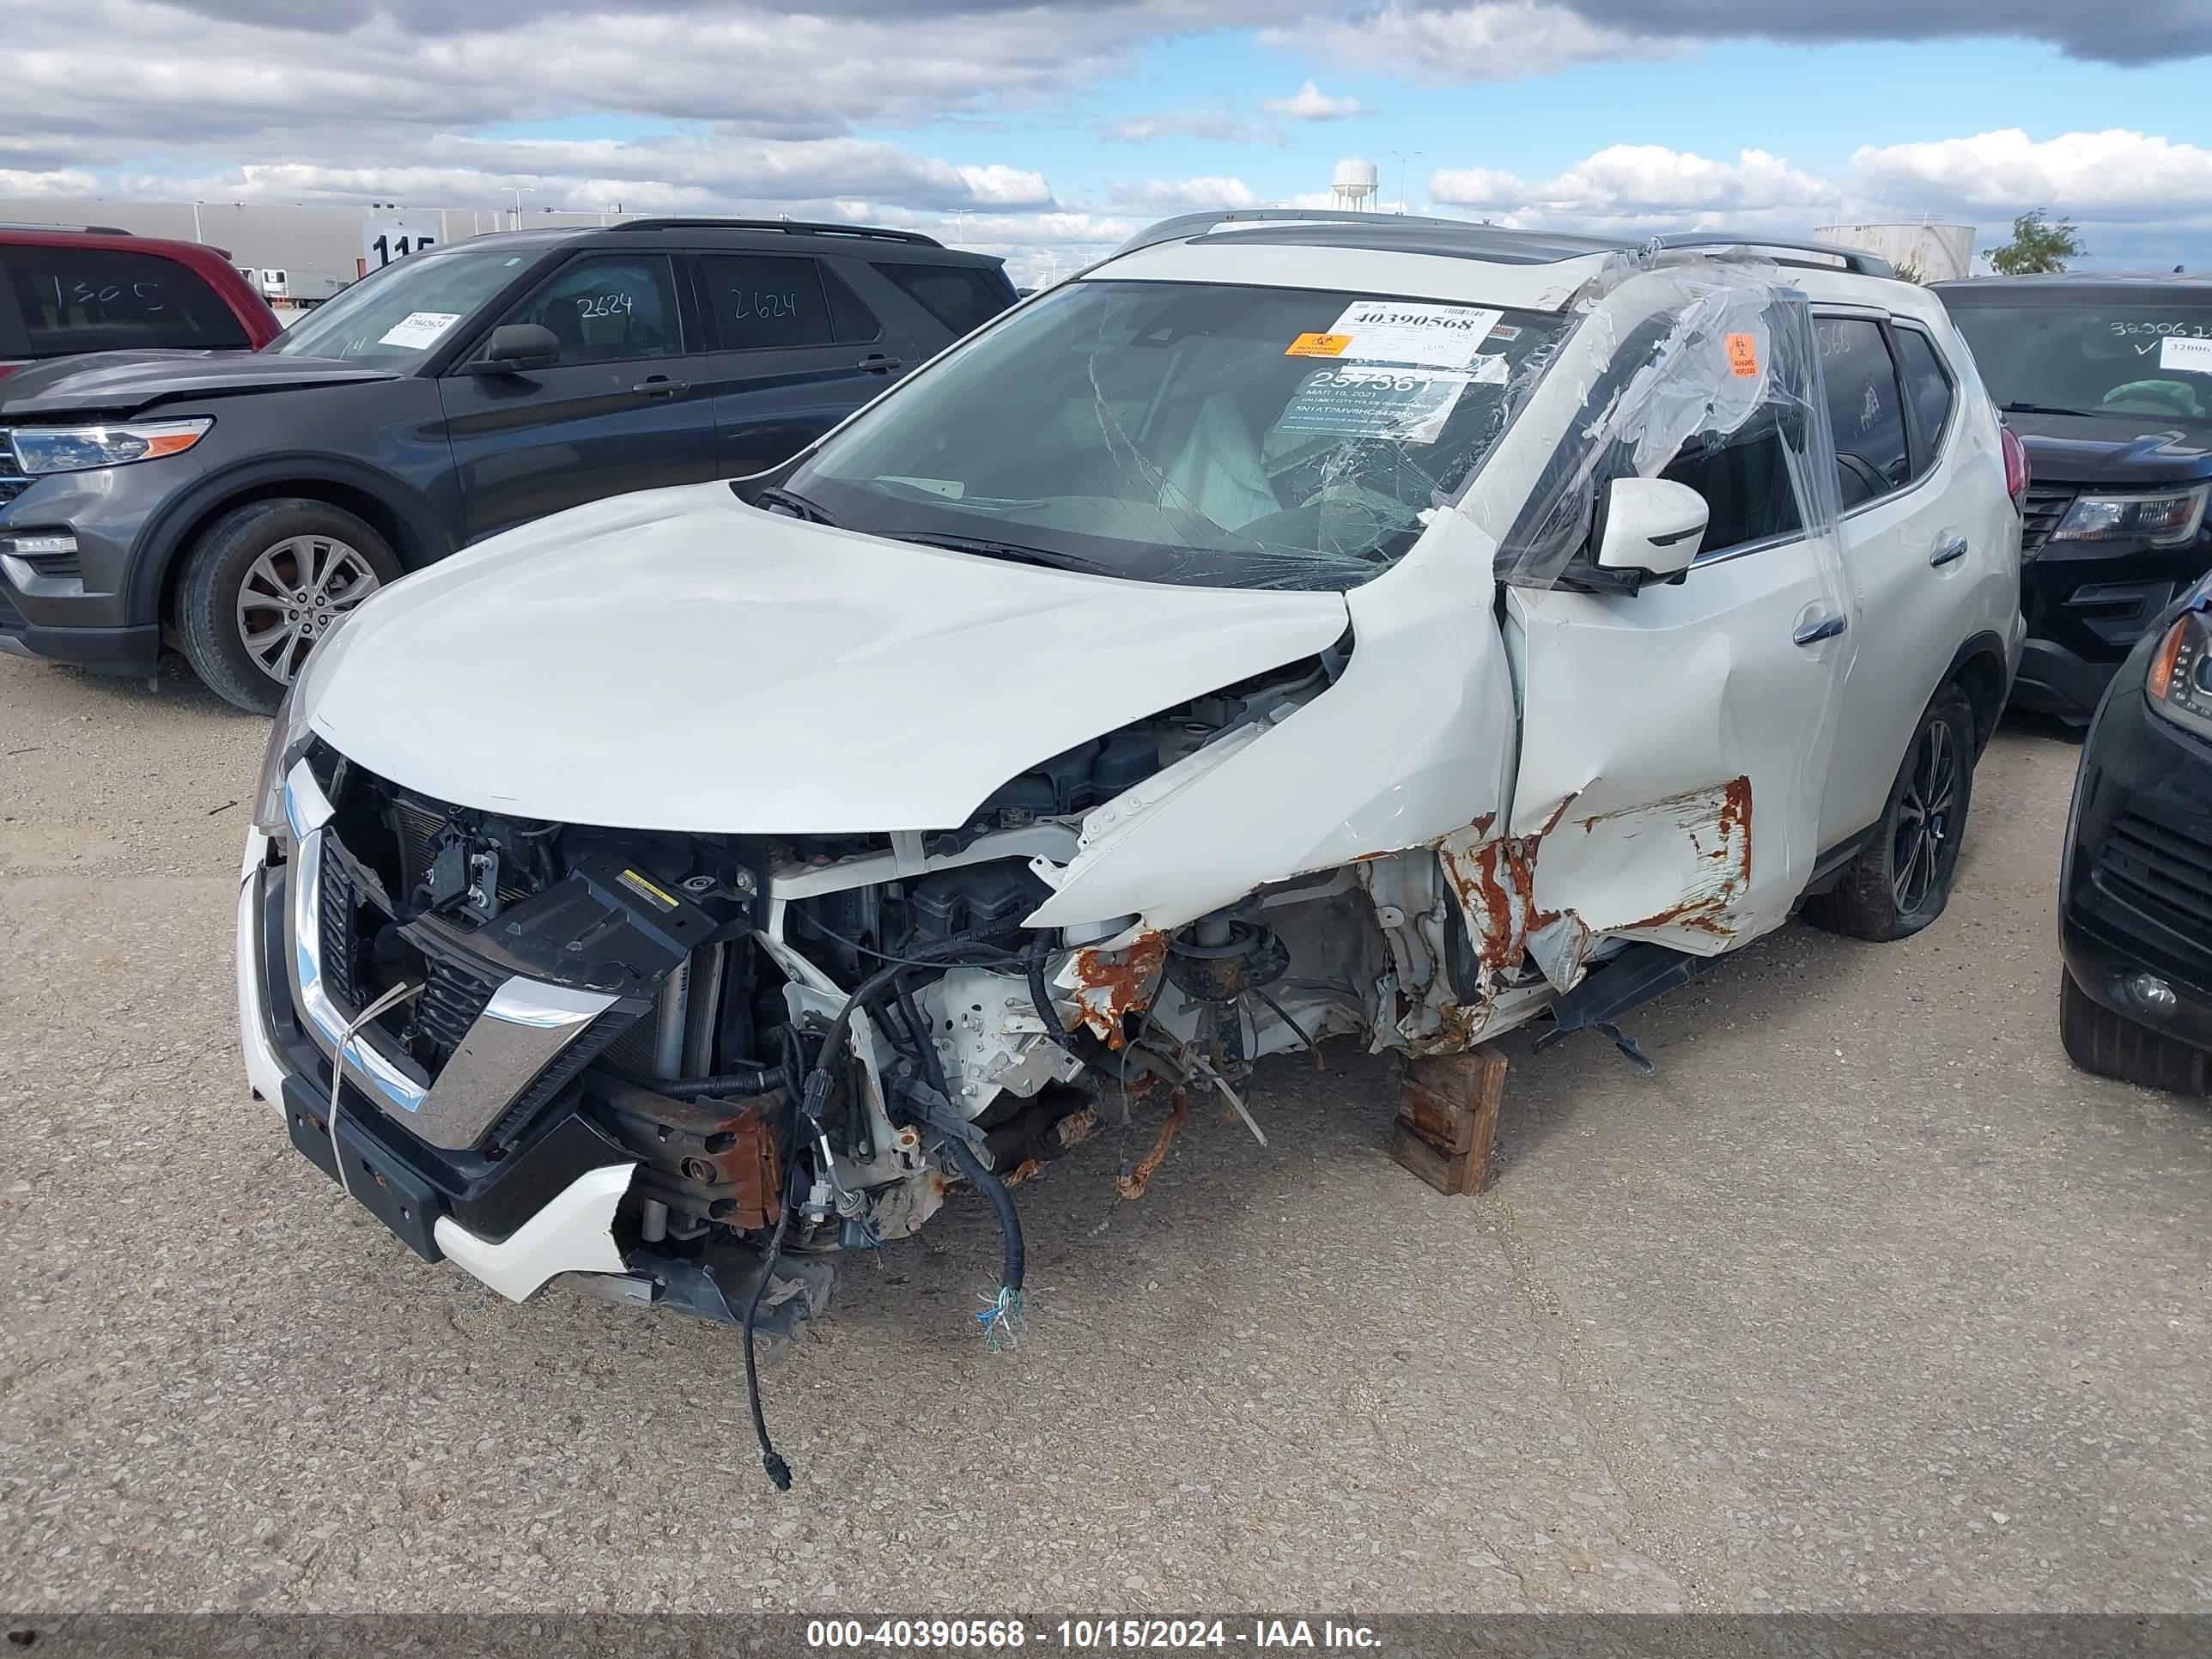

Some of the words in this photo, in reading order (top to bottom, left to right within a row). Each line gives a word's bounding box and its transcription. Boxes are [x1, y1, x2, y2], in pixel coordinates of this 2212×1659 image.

[576, 292, 633, 318] 2624
[731, 289, 797, 319] 2624
[1354, 312, 1475, 331] 40390568
[1309, 371, 1434, 393] 257361
[1382, 401, 1432, 410] DEPARTMENT
